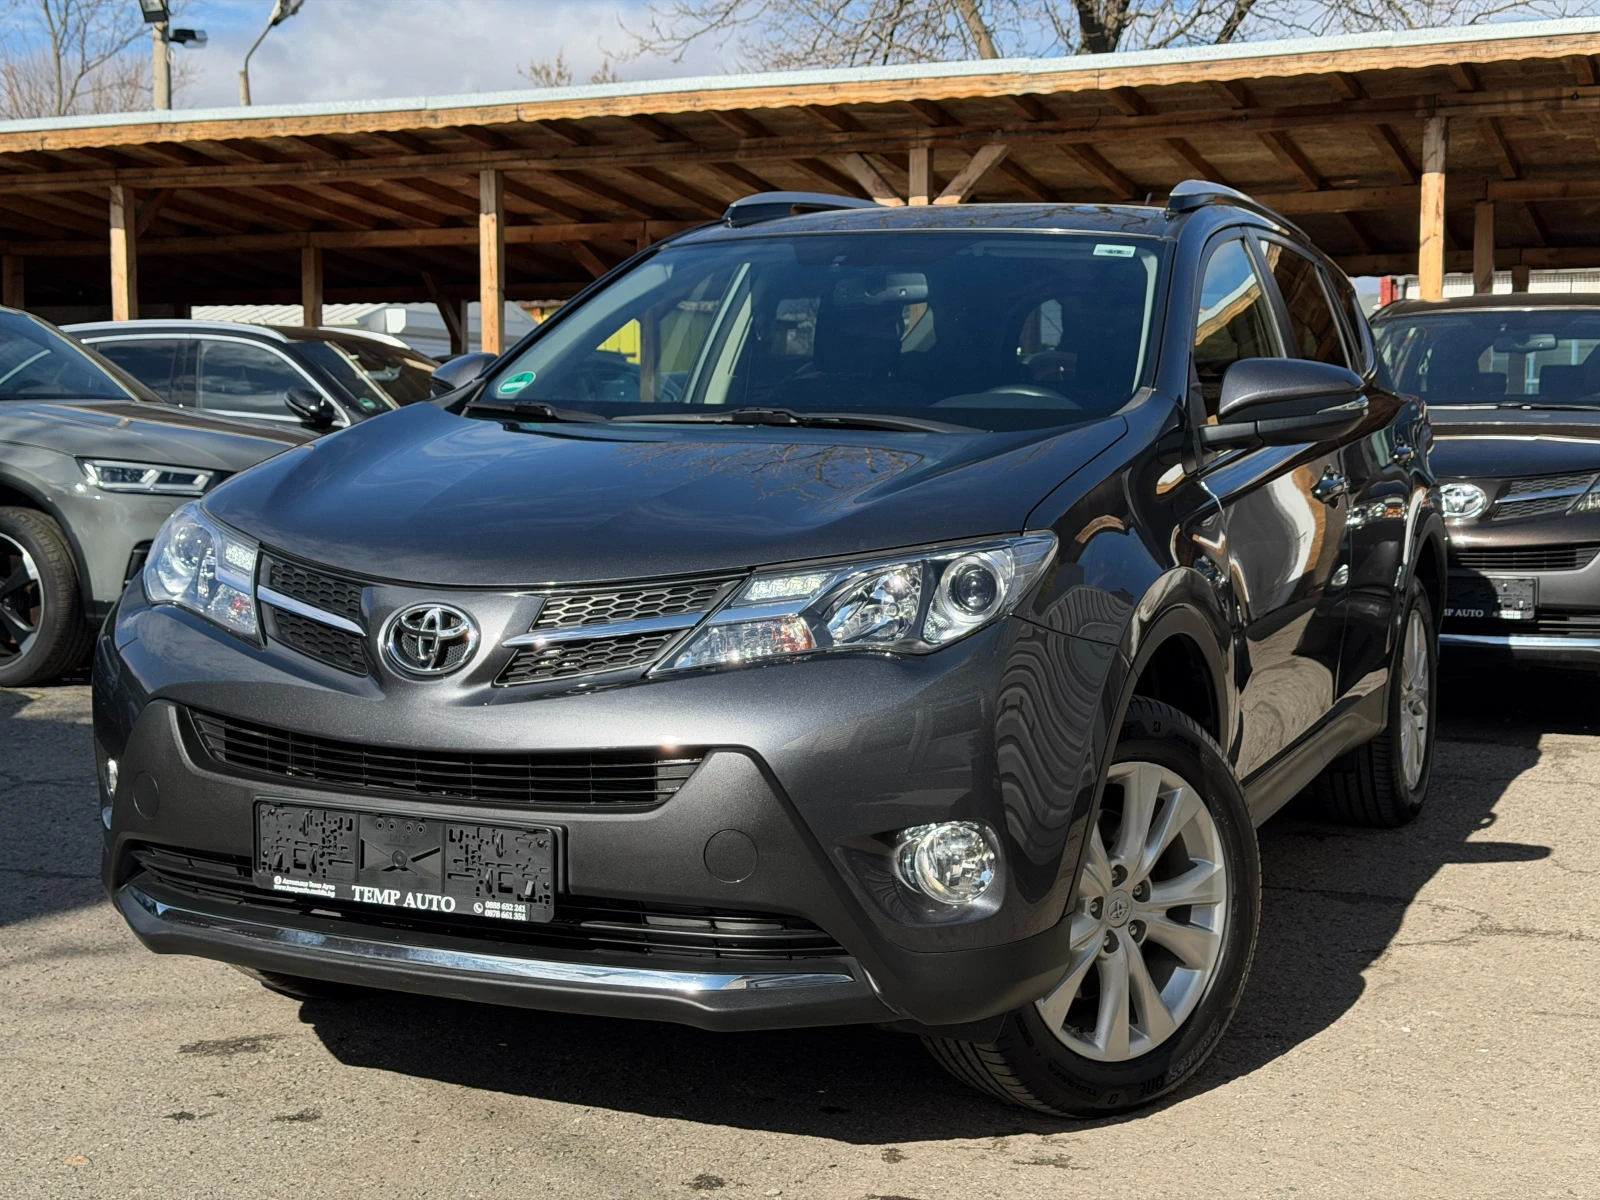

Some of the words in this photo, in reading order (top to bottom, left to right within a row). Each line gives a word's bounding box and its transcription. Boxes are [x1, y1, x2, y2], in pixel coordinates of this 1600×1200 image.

[1454, 608, 1484, 618] AUTO
[351, 885, 401, 906] TEMP
[403, 892, 456, 913] AUTO
